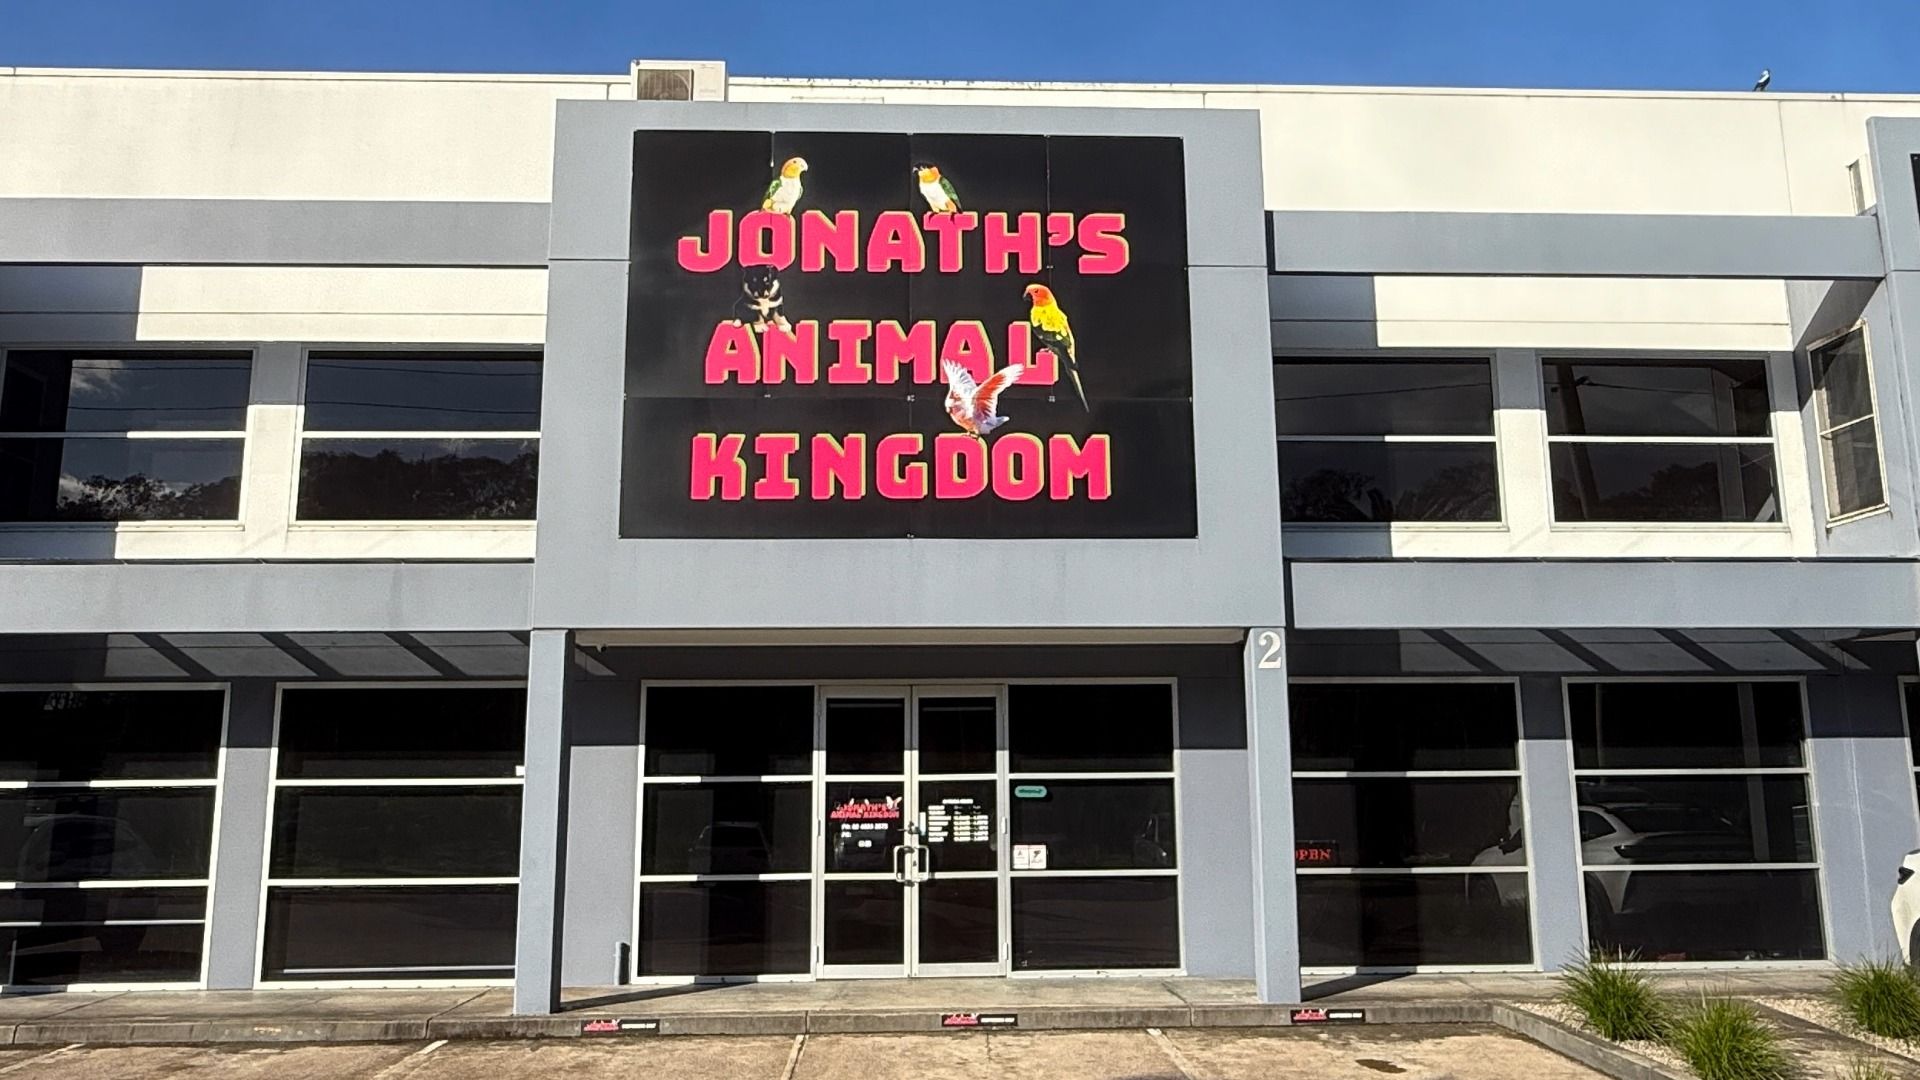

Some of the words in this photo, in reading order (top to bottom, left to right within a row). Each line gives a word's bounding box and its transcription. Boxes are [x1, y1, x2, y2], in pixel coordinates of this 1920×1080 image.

[677, 209, 1131, 275] JONATH'S
[704, 319, 1061, 385] ANIMAL
[690, 432, 1112, 501] KINGDOM
[1258, 630, 1282, 669] 2
